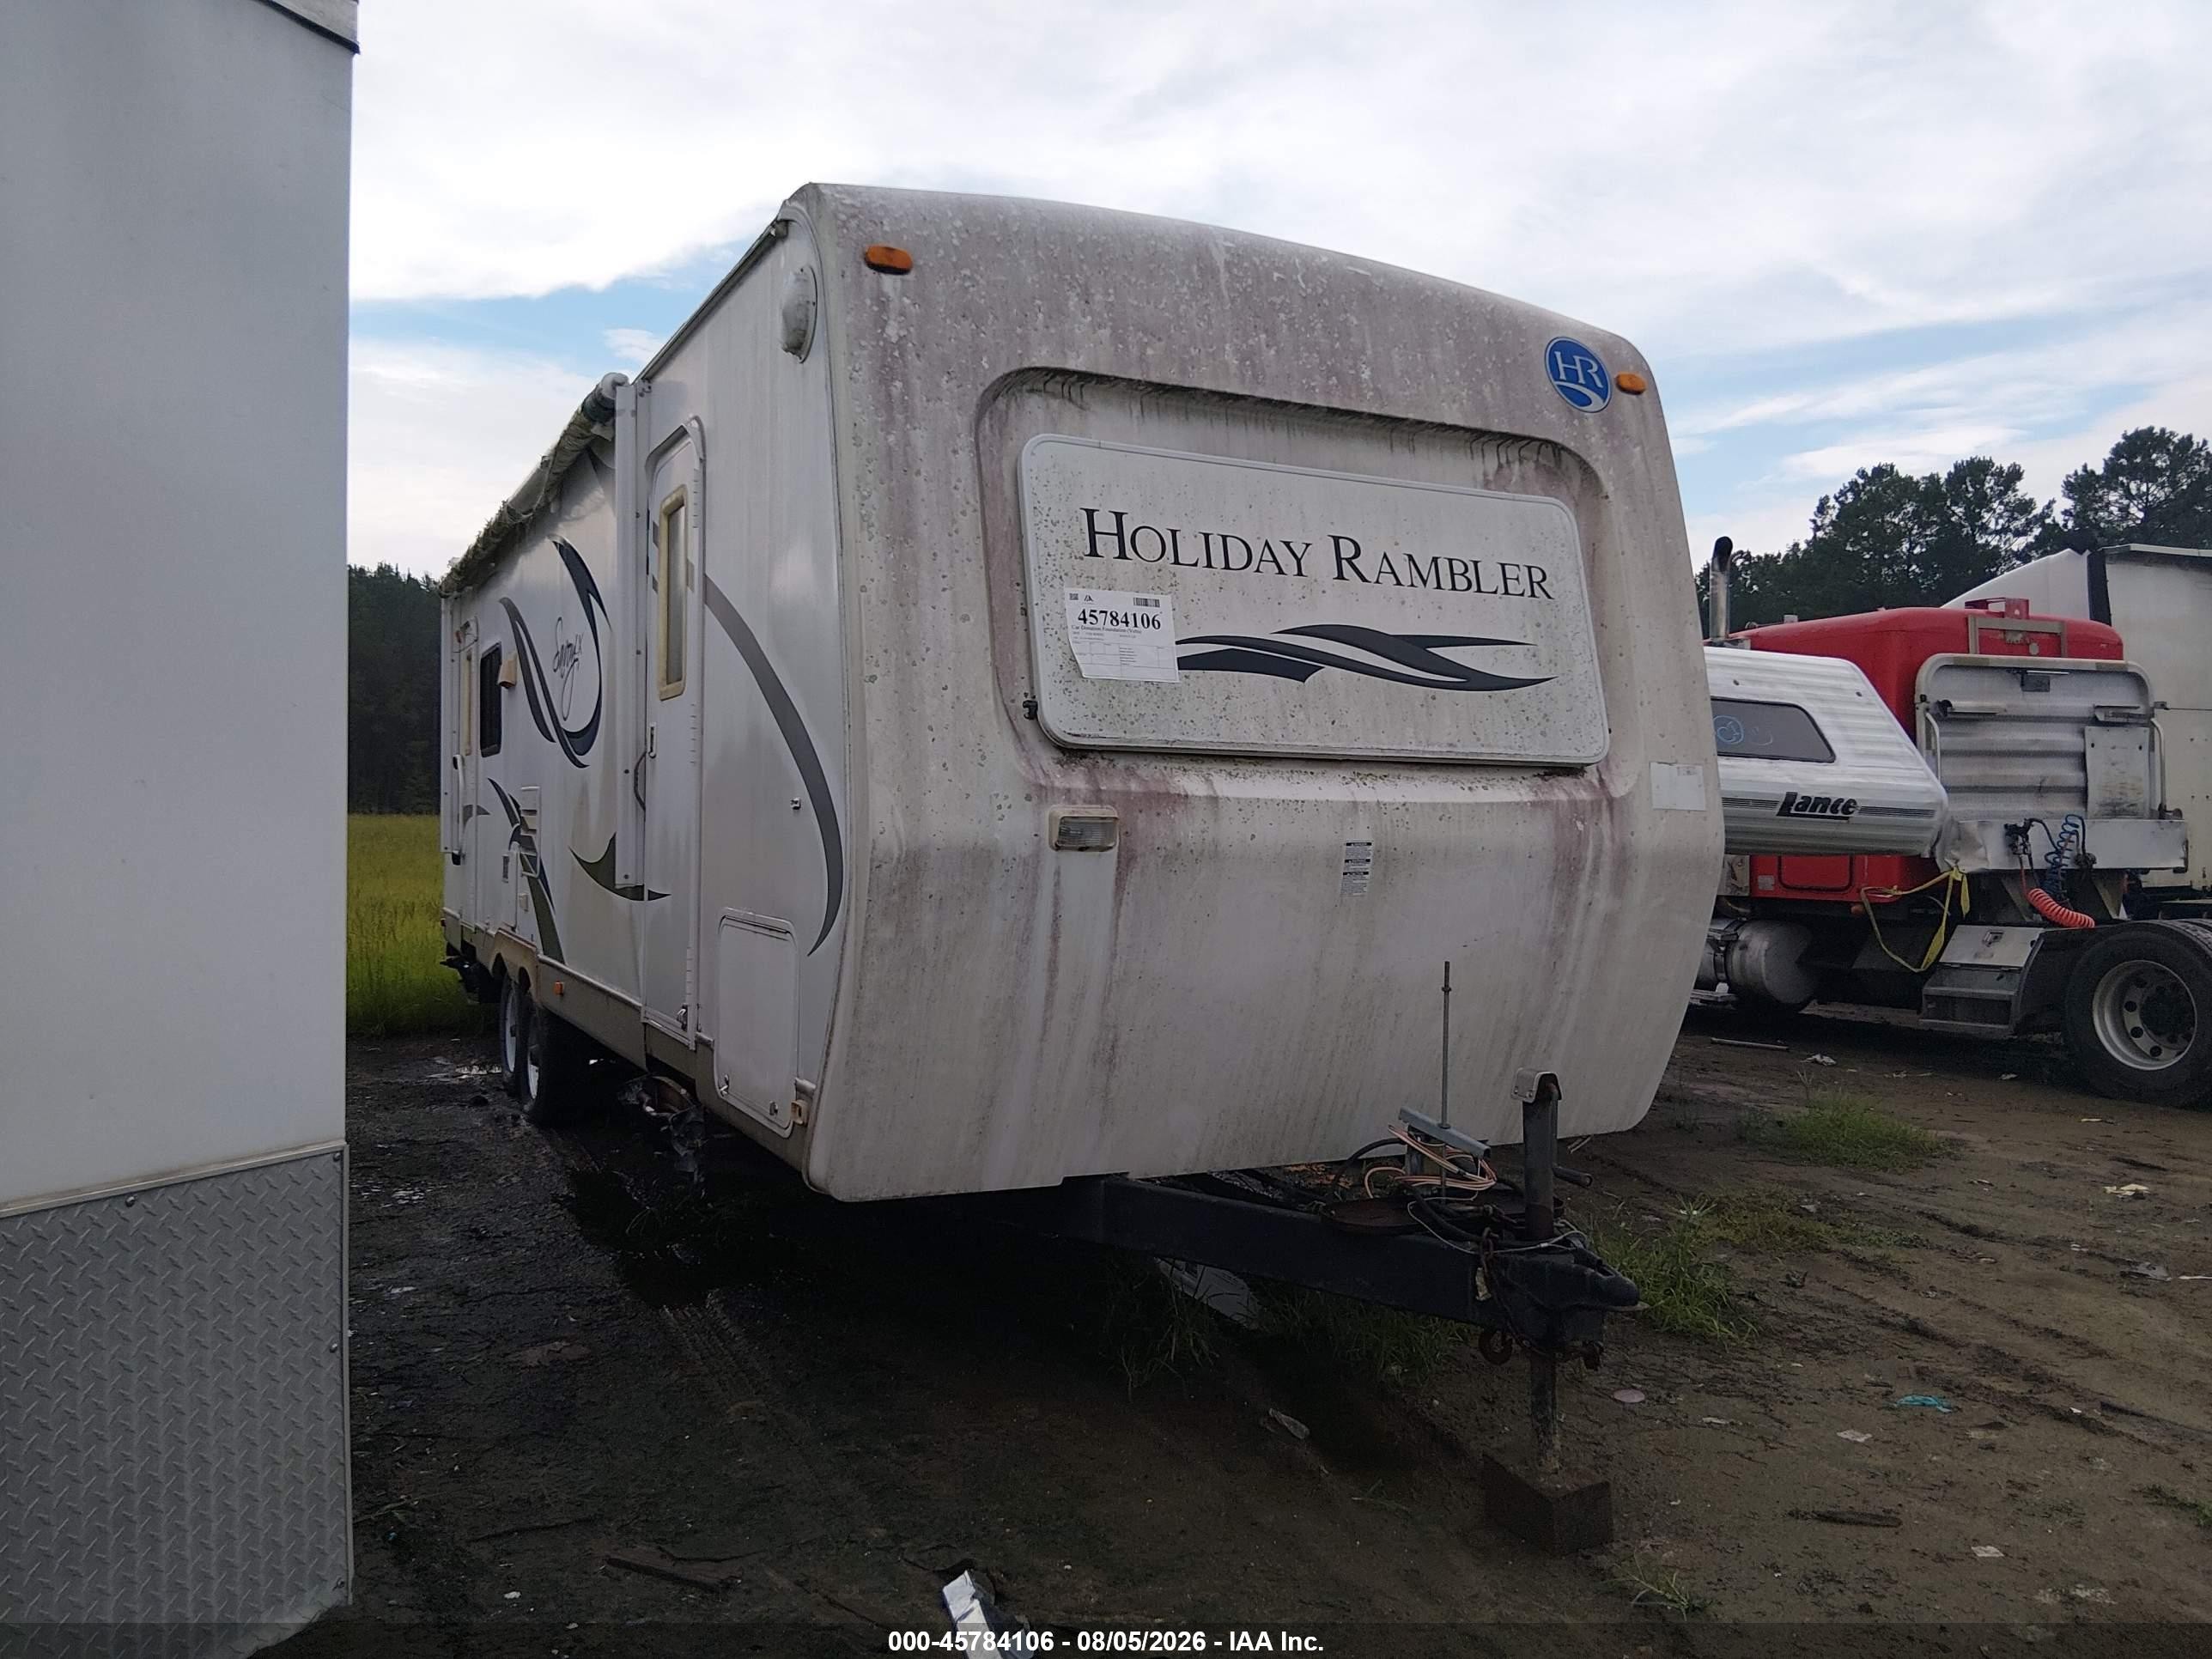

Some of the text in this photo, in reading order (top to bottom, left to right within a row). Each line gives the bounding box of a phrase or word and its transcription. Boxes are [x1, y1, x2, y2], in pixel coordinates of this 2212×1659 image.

[1554, 350, 1604, 388] HR
[1080, 507, 1554, 599] HOLIDAY RAMBLER
[1078, 608, 1161, 630] 45784106
[1776, 791, 1857, 820] Lance
